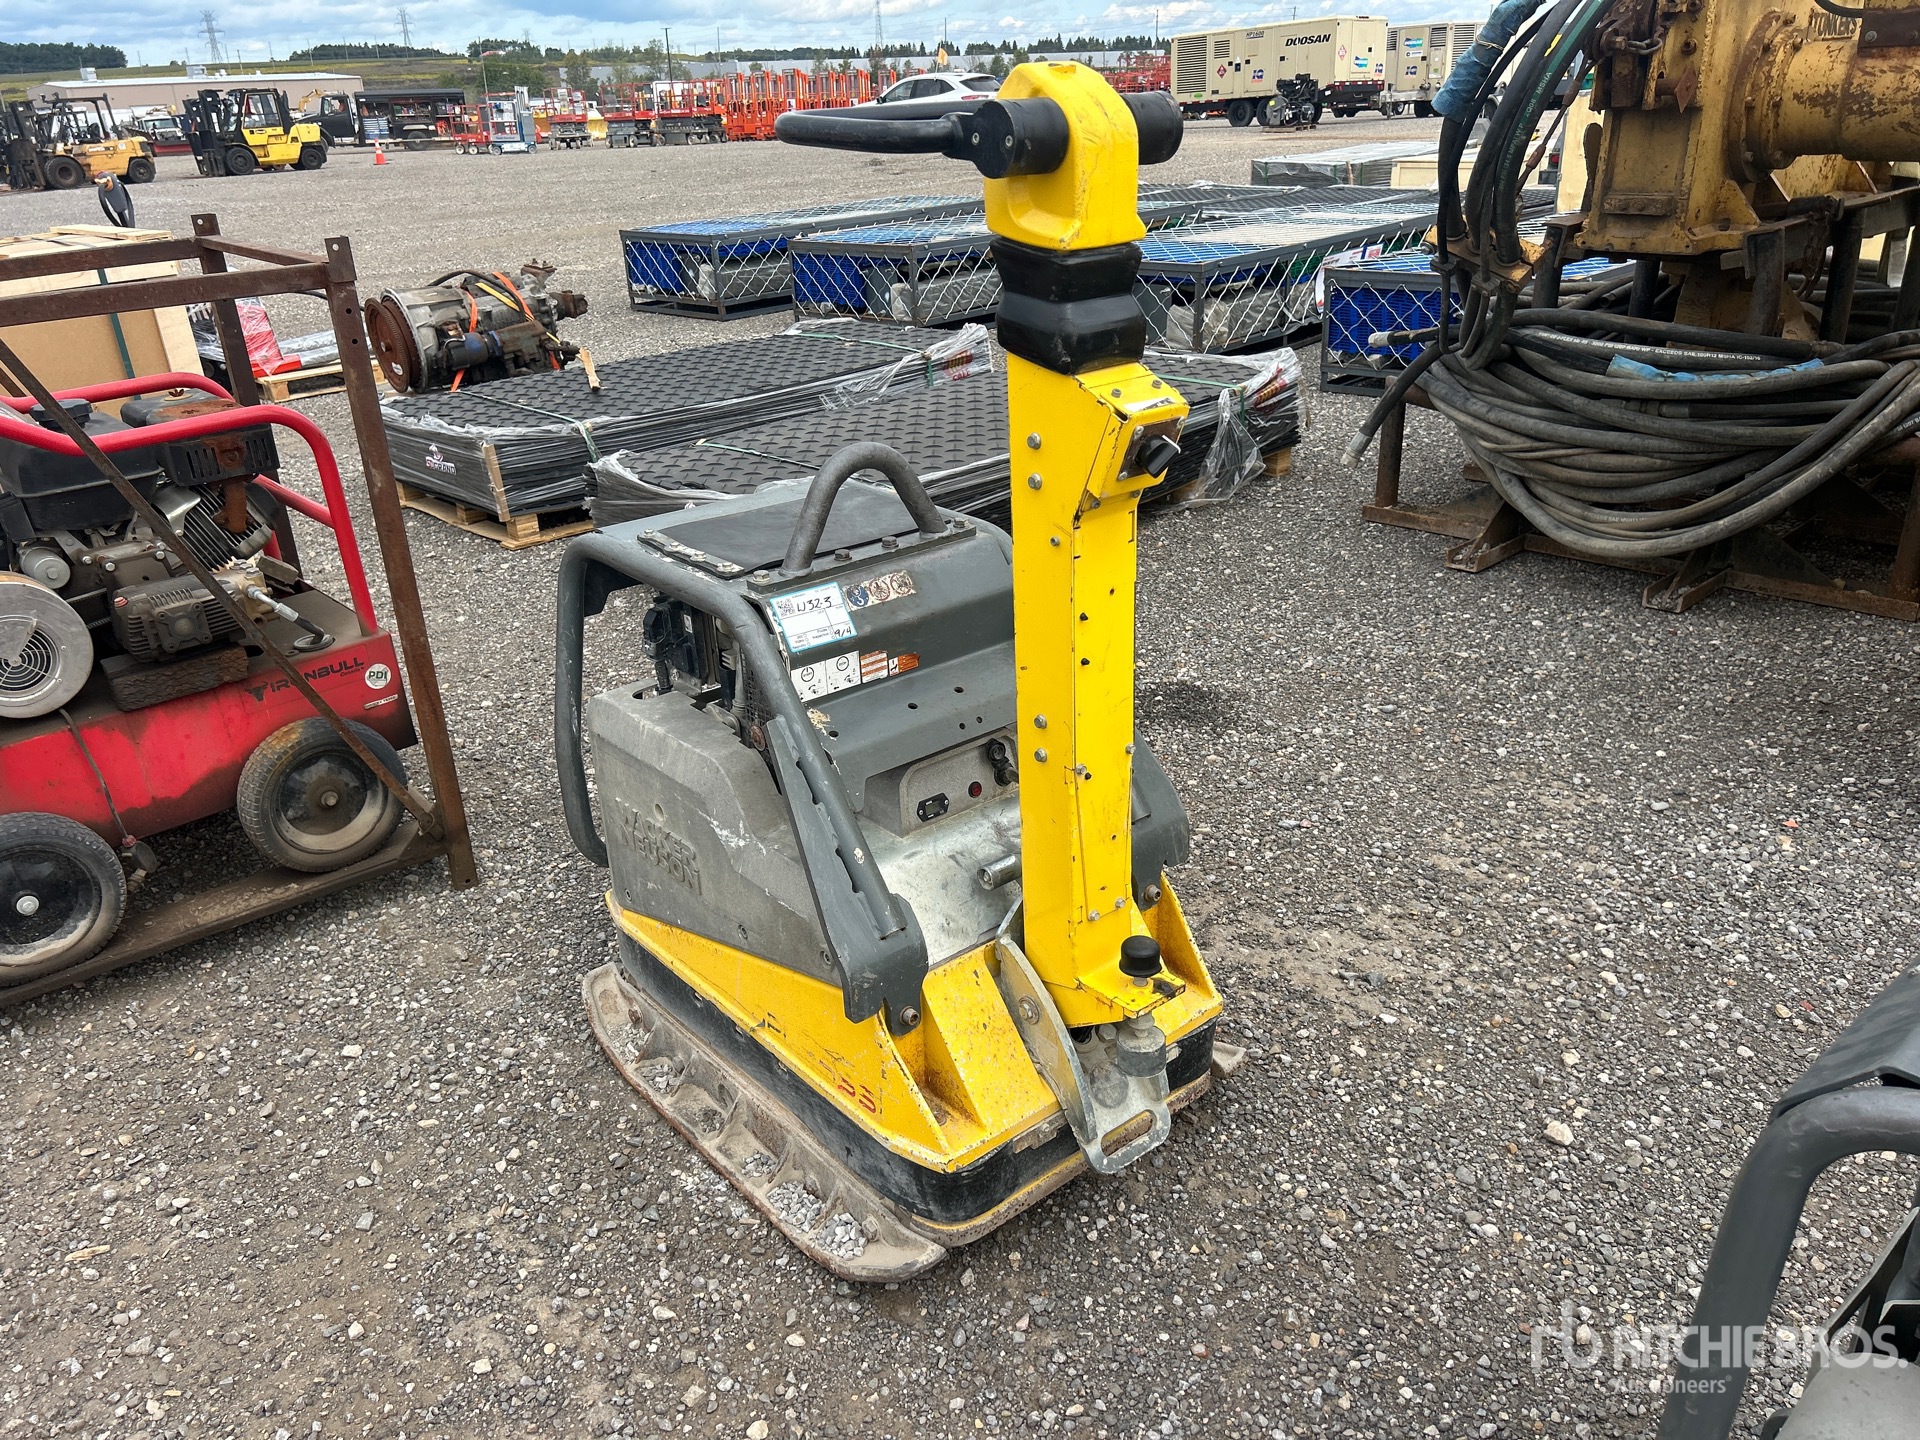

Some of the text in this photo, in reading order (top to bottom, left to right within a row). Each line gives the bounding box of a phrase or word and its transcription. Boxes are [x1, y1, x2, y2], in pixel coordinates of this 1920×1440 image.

[1285, 34, 1331, 47] DOOSAN
[1535, 72, 1553, 95] MSHA
[1654, 347, 1683, 356] EXCEEDS
[834, 626, 852, 638] 9/4
[270, 657, 365, 693] IRNBULL
[368, 670, 388, 679] PDI
